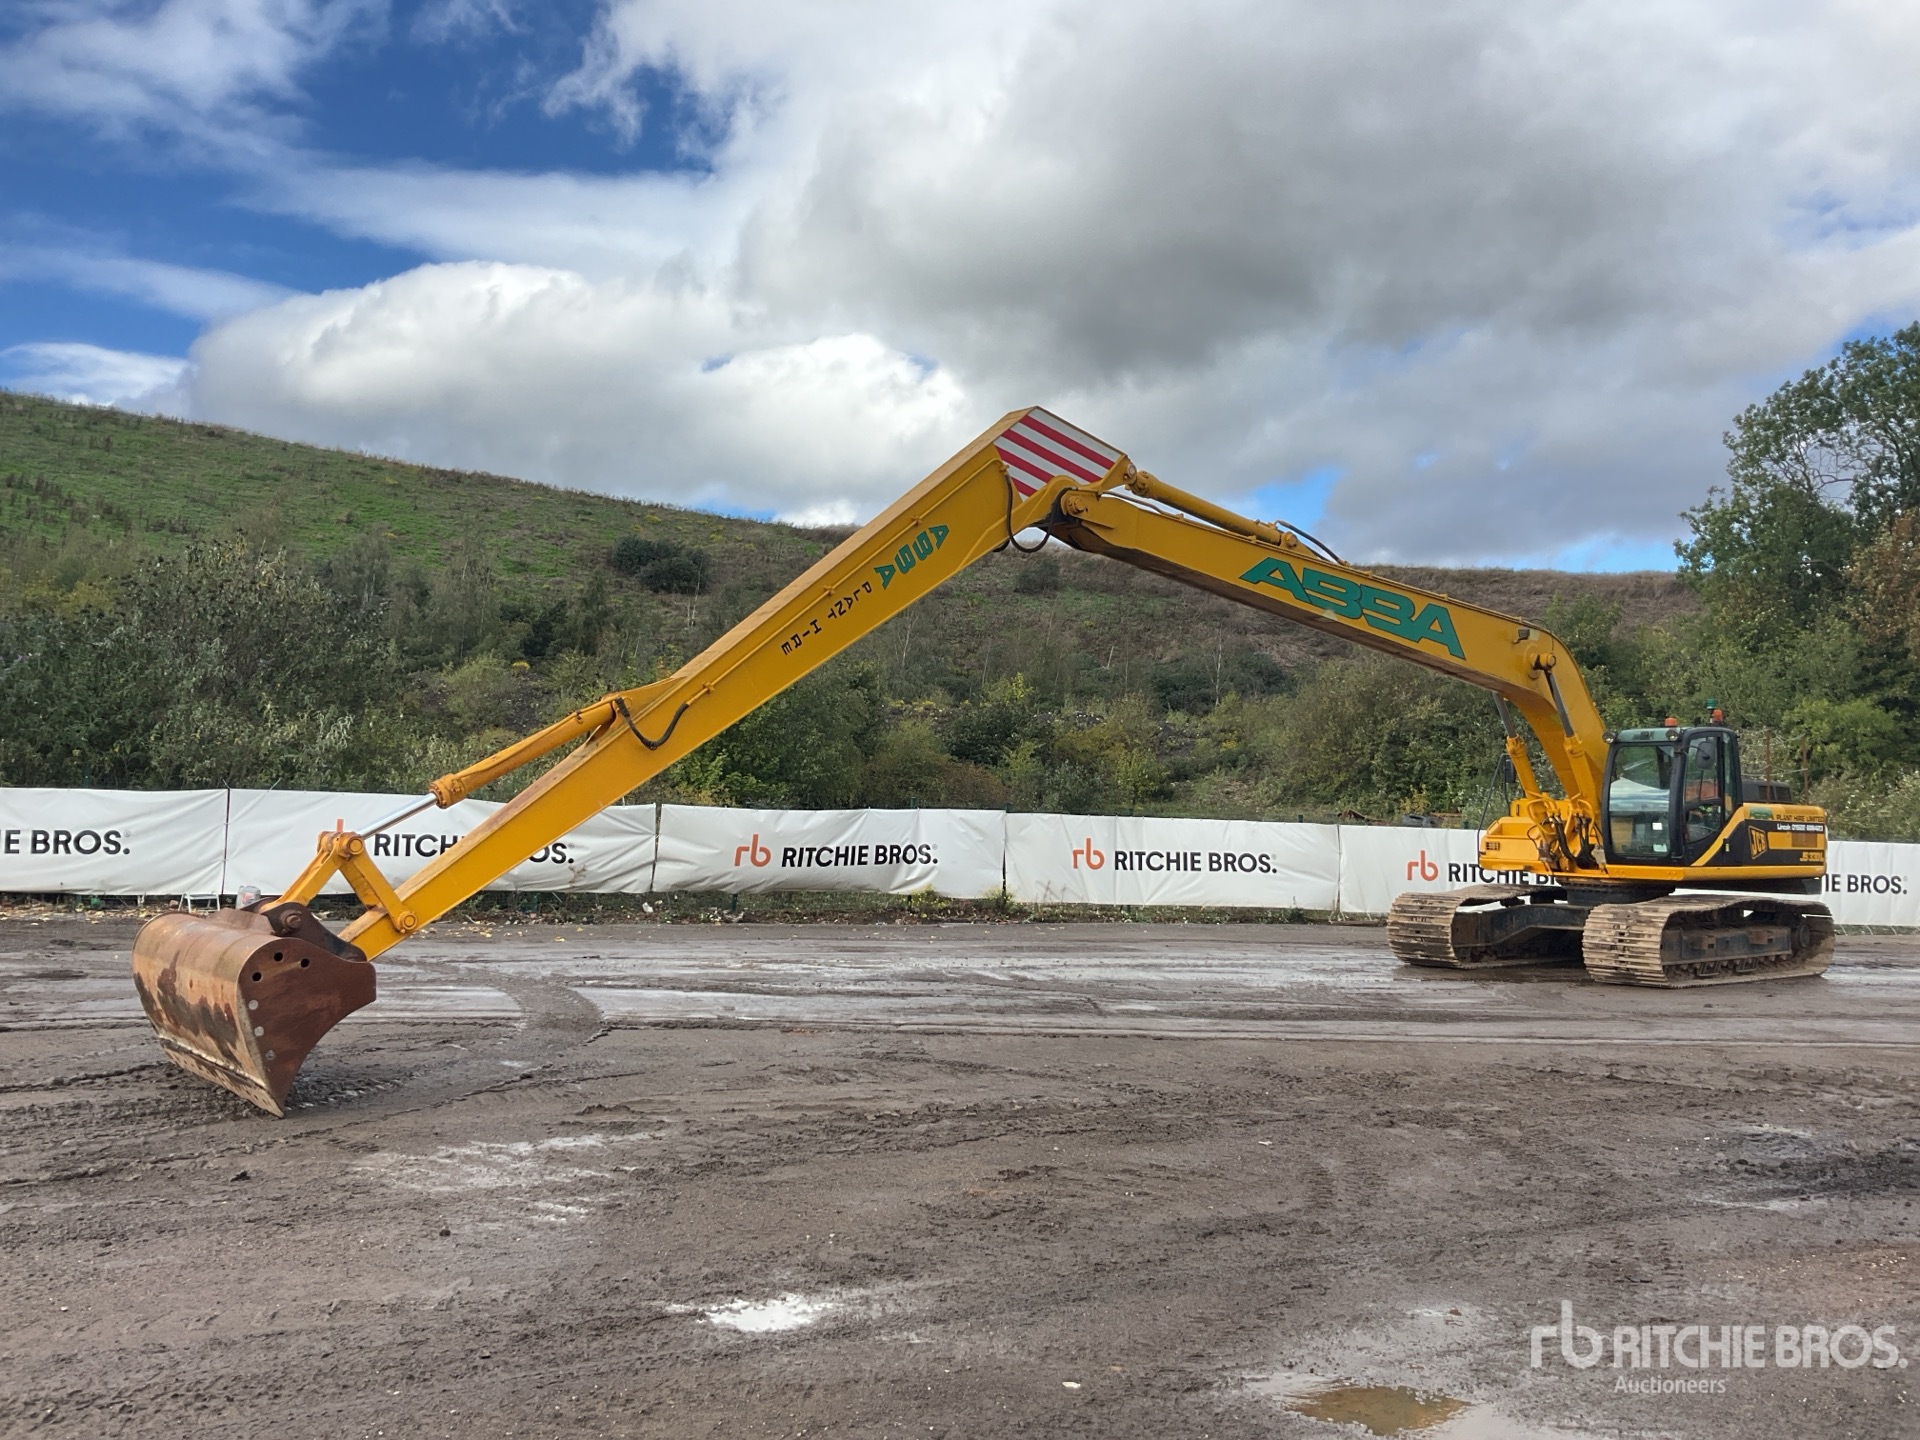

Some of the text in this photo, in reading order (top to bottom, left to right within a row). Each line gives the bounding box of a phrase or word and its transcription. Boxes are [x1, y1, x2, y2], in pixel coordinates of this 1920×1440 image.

[874, 524, 949, 590] ABBA
[780, 581, 873, 655] PLANT HIRE
[1238, 556, 1467, 660] ABBA
[30, 829, 131, 855] BROS.
[373, 833, 466, 857] RITCH
[1750, 829, 1766, 856] JCB
[781, 845, 869, 868] RITCHIE
[874, 843, 938, 865] BROS.
[1114, 850, 1201, 872] RITCHIE
[1208, 852, 1278, 874] BROS.
[1847, 874, 1908, 895] BROS.
